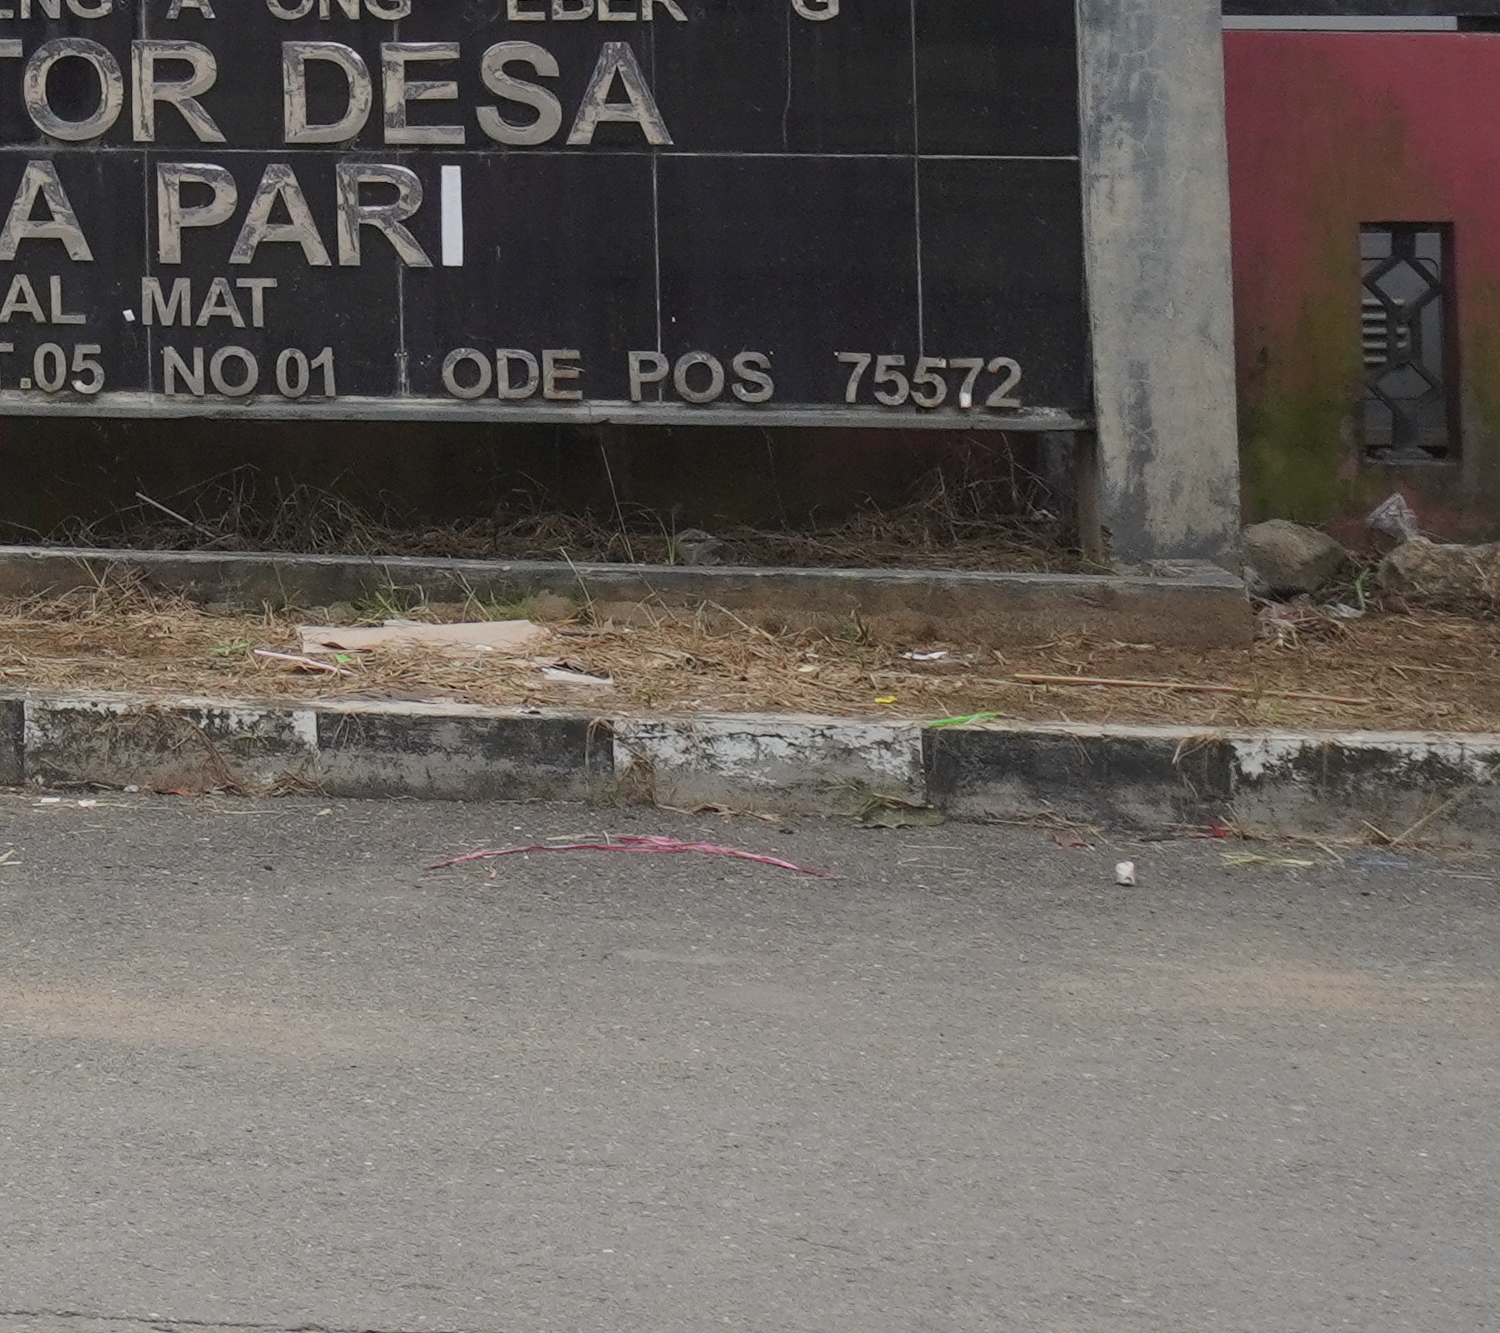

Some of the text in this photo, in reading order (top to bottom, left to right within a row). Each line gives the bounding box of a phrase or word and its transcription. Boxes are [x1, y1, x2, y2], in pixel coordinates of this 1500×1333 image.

[280, 39, 675, 147] DESA
[155, 161, 465, 268] PARI
[627, 351, 776, 405] POS
[835, 351, 1023, 410] 75572
